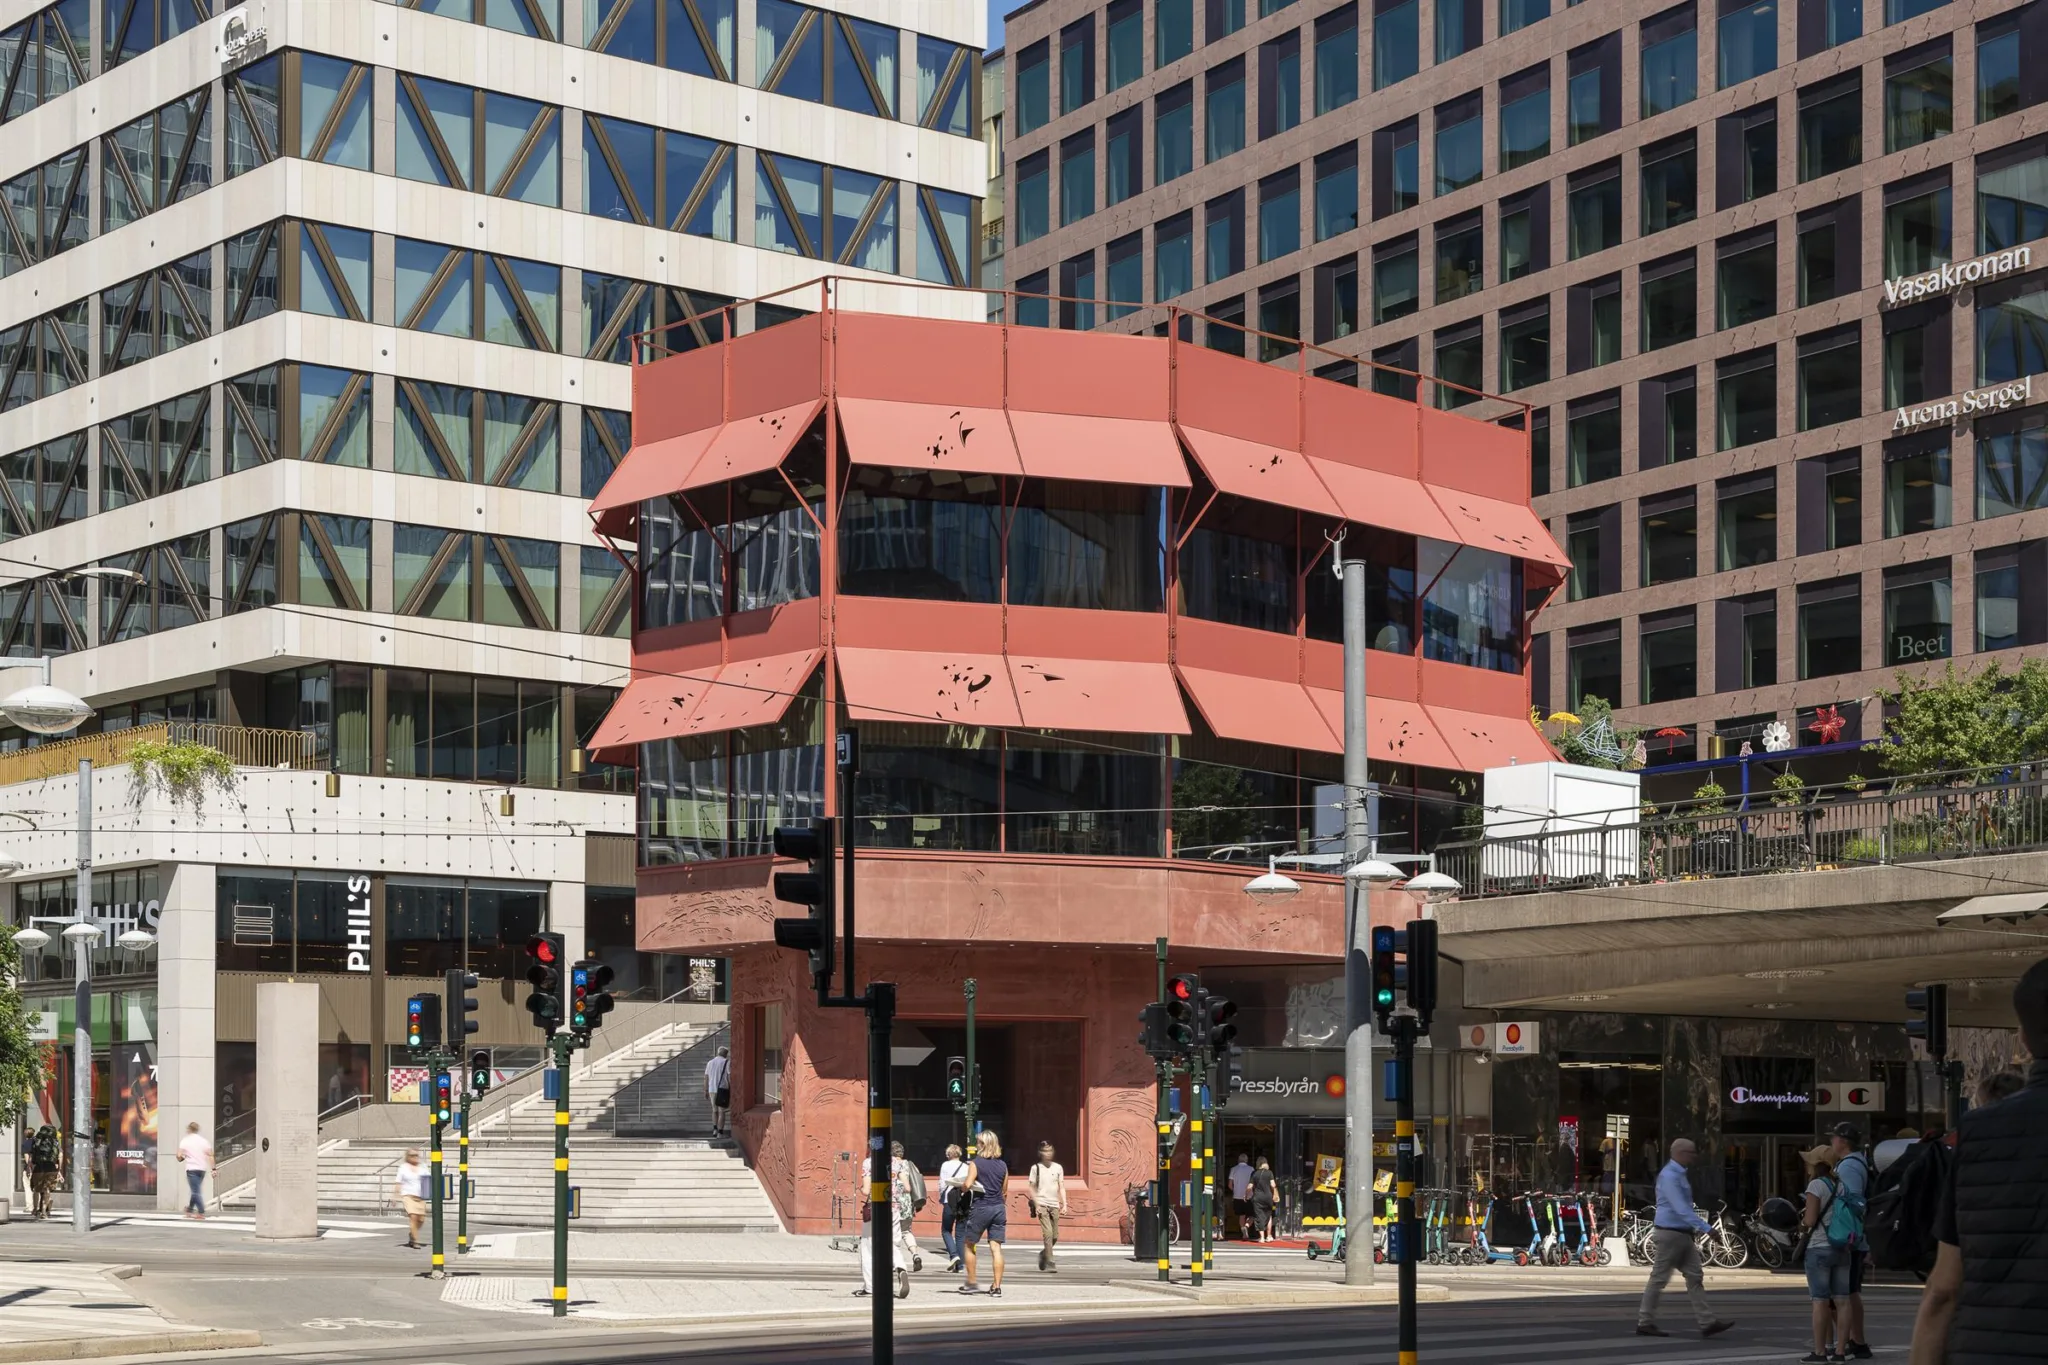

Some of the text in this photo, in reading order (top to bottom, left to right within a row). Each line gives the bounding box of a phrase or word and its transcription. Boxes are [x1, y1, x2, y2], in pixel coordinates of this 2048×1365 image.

[1885, 246, 2031, 303] Vasakronan
[1892, 375, 2033, 430] Arena Sergel
[1898, 634, 1946, 659] Beet
[347, 875, 371, 971] PHIL'S
[690, 958, 716, 967] PHIL'S
[1730, 1086, 1810, 1109] Champion
